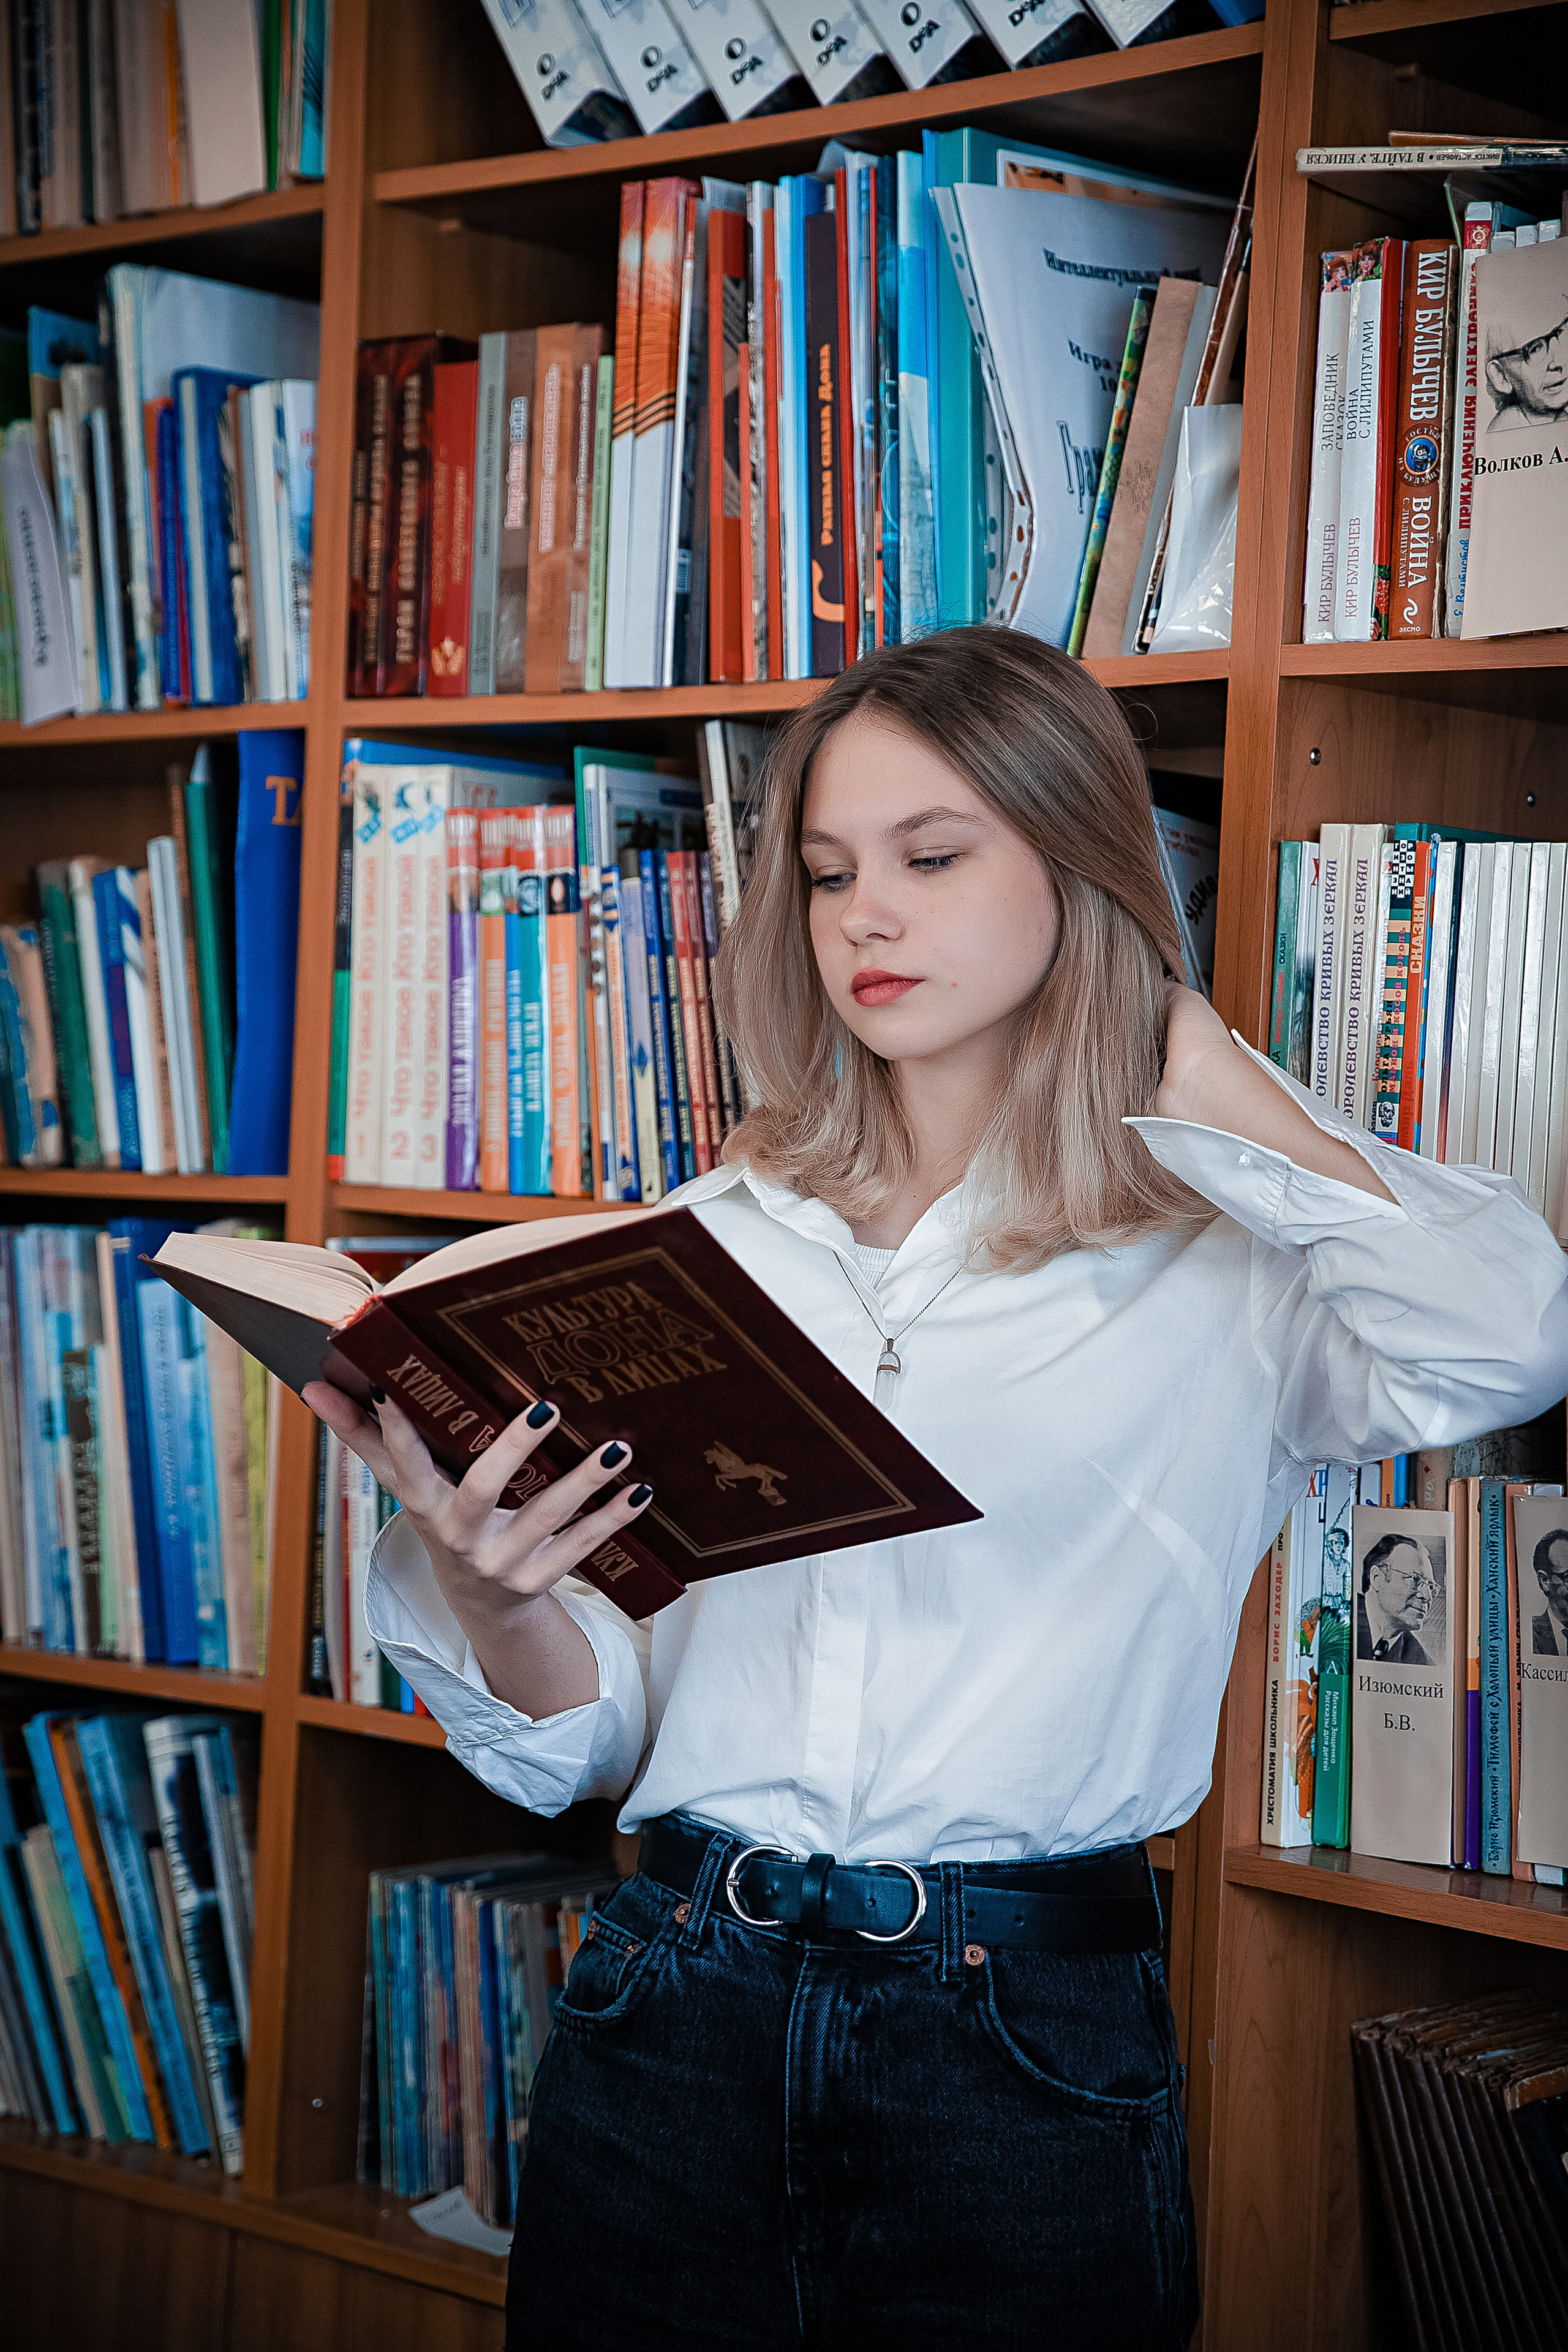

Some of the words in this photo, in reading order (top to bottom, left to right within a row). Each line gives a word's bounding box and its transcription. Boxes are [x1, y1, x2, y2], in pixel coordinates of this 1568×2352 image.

[1306, 153, 1355, 164] ЕНИСЕЯ
[1357, 154, 1366, 164] У
[1370, 153, 1413, 166] ТАЙГЕ,
[1417, 153, 1425, 163] В
[1417, 250, 1447, 300] КИР
[1360, 320, 1374, 425] ЛИЛИПУТАМИ
[1409, 307, 1444, 421] БУЛЫЧЕВ
[1321, 352, 1340, 451] ЗАПОВЕДНИК
[1346, 388, 1359, 440] ВОЙНА
[1458, 395, 1477, 529] ПРИКЛЮЧЕНИЯ
[1474, 453, 1544, 475] Волков
[1548, 445, 1568, 465] А.
[1321, 524, 1335, 590] БУЛЫЧЕВ
[1347, 517, 1360, 586] БУЛЫЧЕВ
[1398, 505, 1409, 587] ЛИЛИПУТАМИ
[1408, 496, 1434, 588] ВОЙНА
[1318, 594, 1330, 622] КИР
[1345, 589, 1357, 618] КИР
[1320, 929, 1334, 1002] КРИВЫХ
[1349, 929, 1365, 1002] КРИВЫХ
[1396, 927, 1406, 977] КОРОЛЬ
[1410, 896, 1426, 974] СКАЗКИ
[1384, 1000, 1393, 1048] ГУРЬЯН
[1393, 981, 1402, 1023] КОСОЙ
[1316, 1006, 1330, 1101] ОЛЕВСТВО
[1343, 1006, 1359, 1120] ОРОЛЕВСТВО
[1381, 1052, 1390, 1093] ОЛЬГА
[1389, 1040, 1399, 1092] МАРИОН
[502, 1281, 662, 1343] КУЛЬТУРА
[527, 1307, 715, 1385] ДОНА
[564, 1376, 603, 1403] В
[601, 1343, 728, 1396] ЛИЦАХ
[386, 1353, 464, 1417] ЛИЦАХ
[448, 1411, 479, 1435] В
[1268, 1679, 1278, 1749] ШКОЛЬНИКА
[1359, 1675, 1444, 1698] Изюмский
[1384, 1713, 1415, 1732] Б.В.
[1267, 1752, 1276, 1826] ХРЕСТОМАТИЯ
